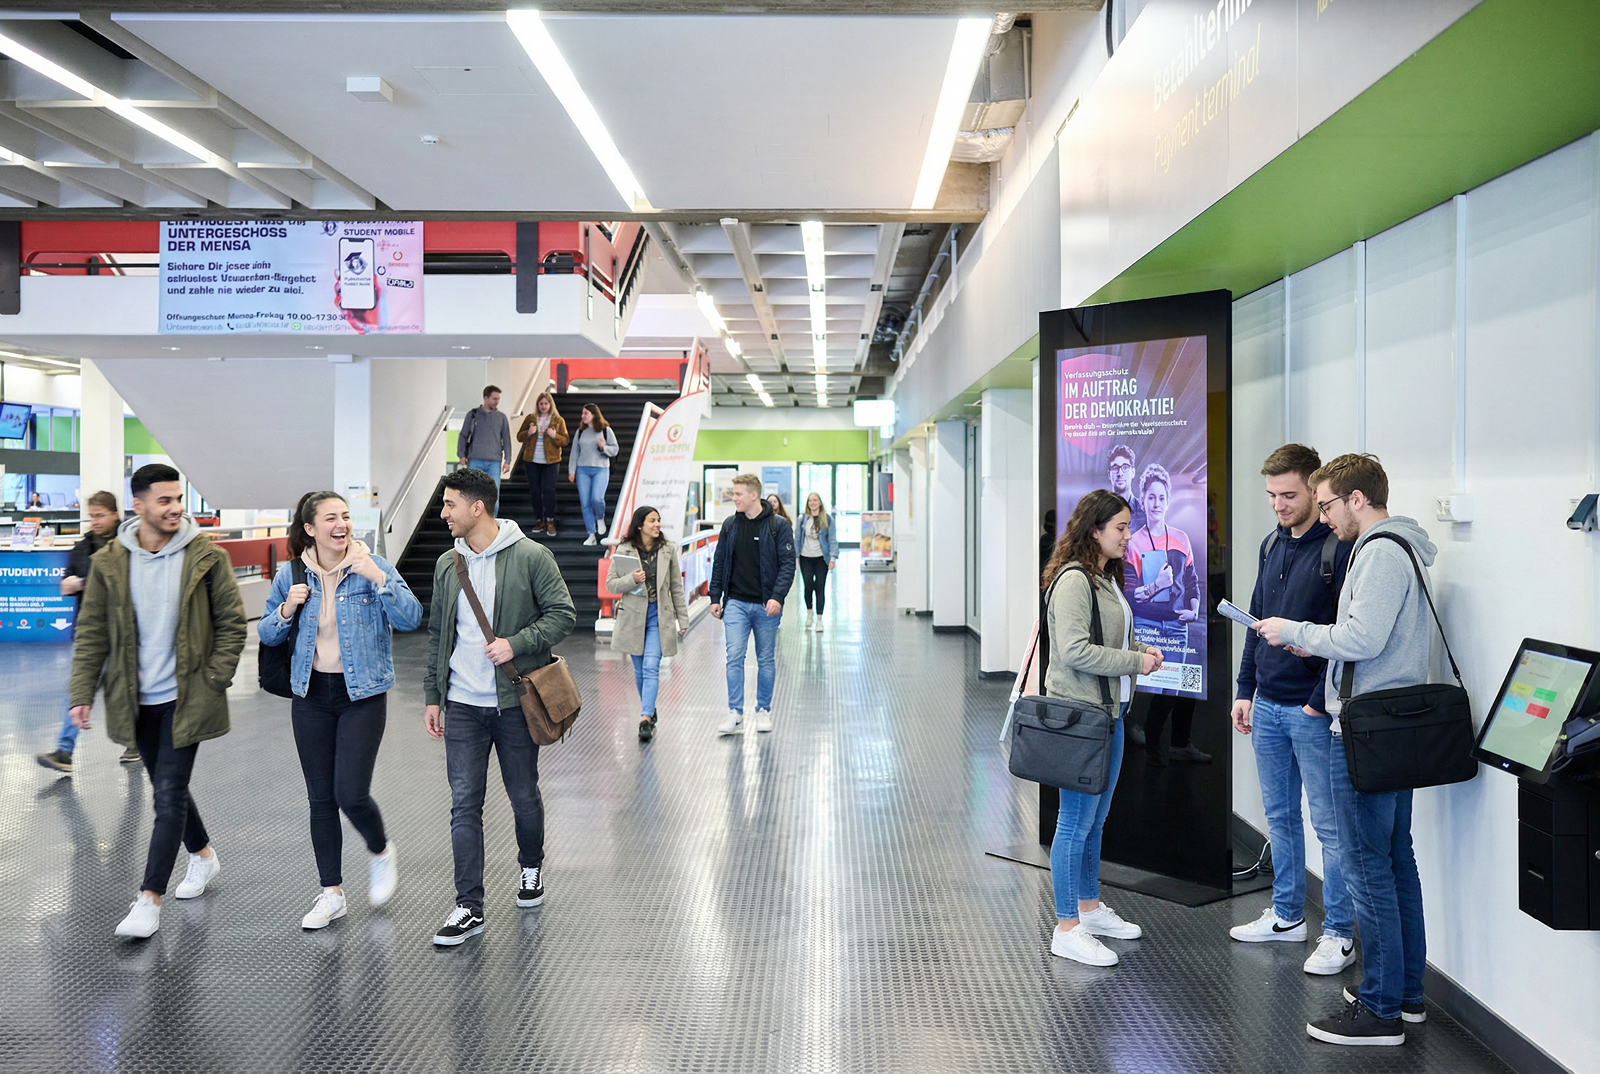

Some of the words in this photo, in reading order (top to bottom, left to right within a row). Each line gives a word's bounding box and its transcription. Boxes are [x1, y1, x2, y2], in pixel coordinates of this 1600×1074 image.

[168, 227, 288, 239] UNTERGESCHOSS
[384, 228, 415, 236] MOBILE
[167, 240, 196, 252] DER
[200, 240, 252, 252] MENSA
[167, 285, 186, 295] und
[217, 285, 233, 295] nie
[268, 285, 281, 293] zu
[1065, 382, 1079, 399] IM
[1082, 378, 1138, 398] AUFTRAG
[1065, 402, 1088, 420] DER
[1090, 397, 1175, 419] DEMOKRATIE!
